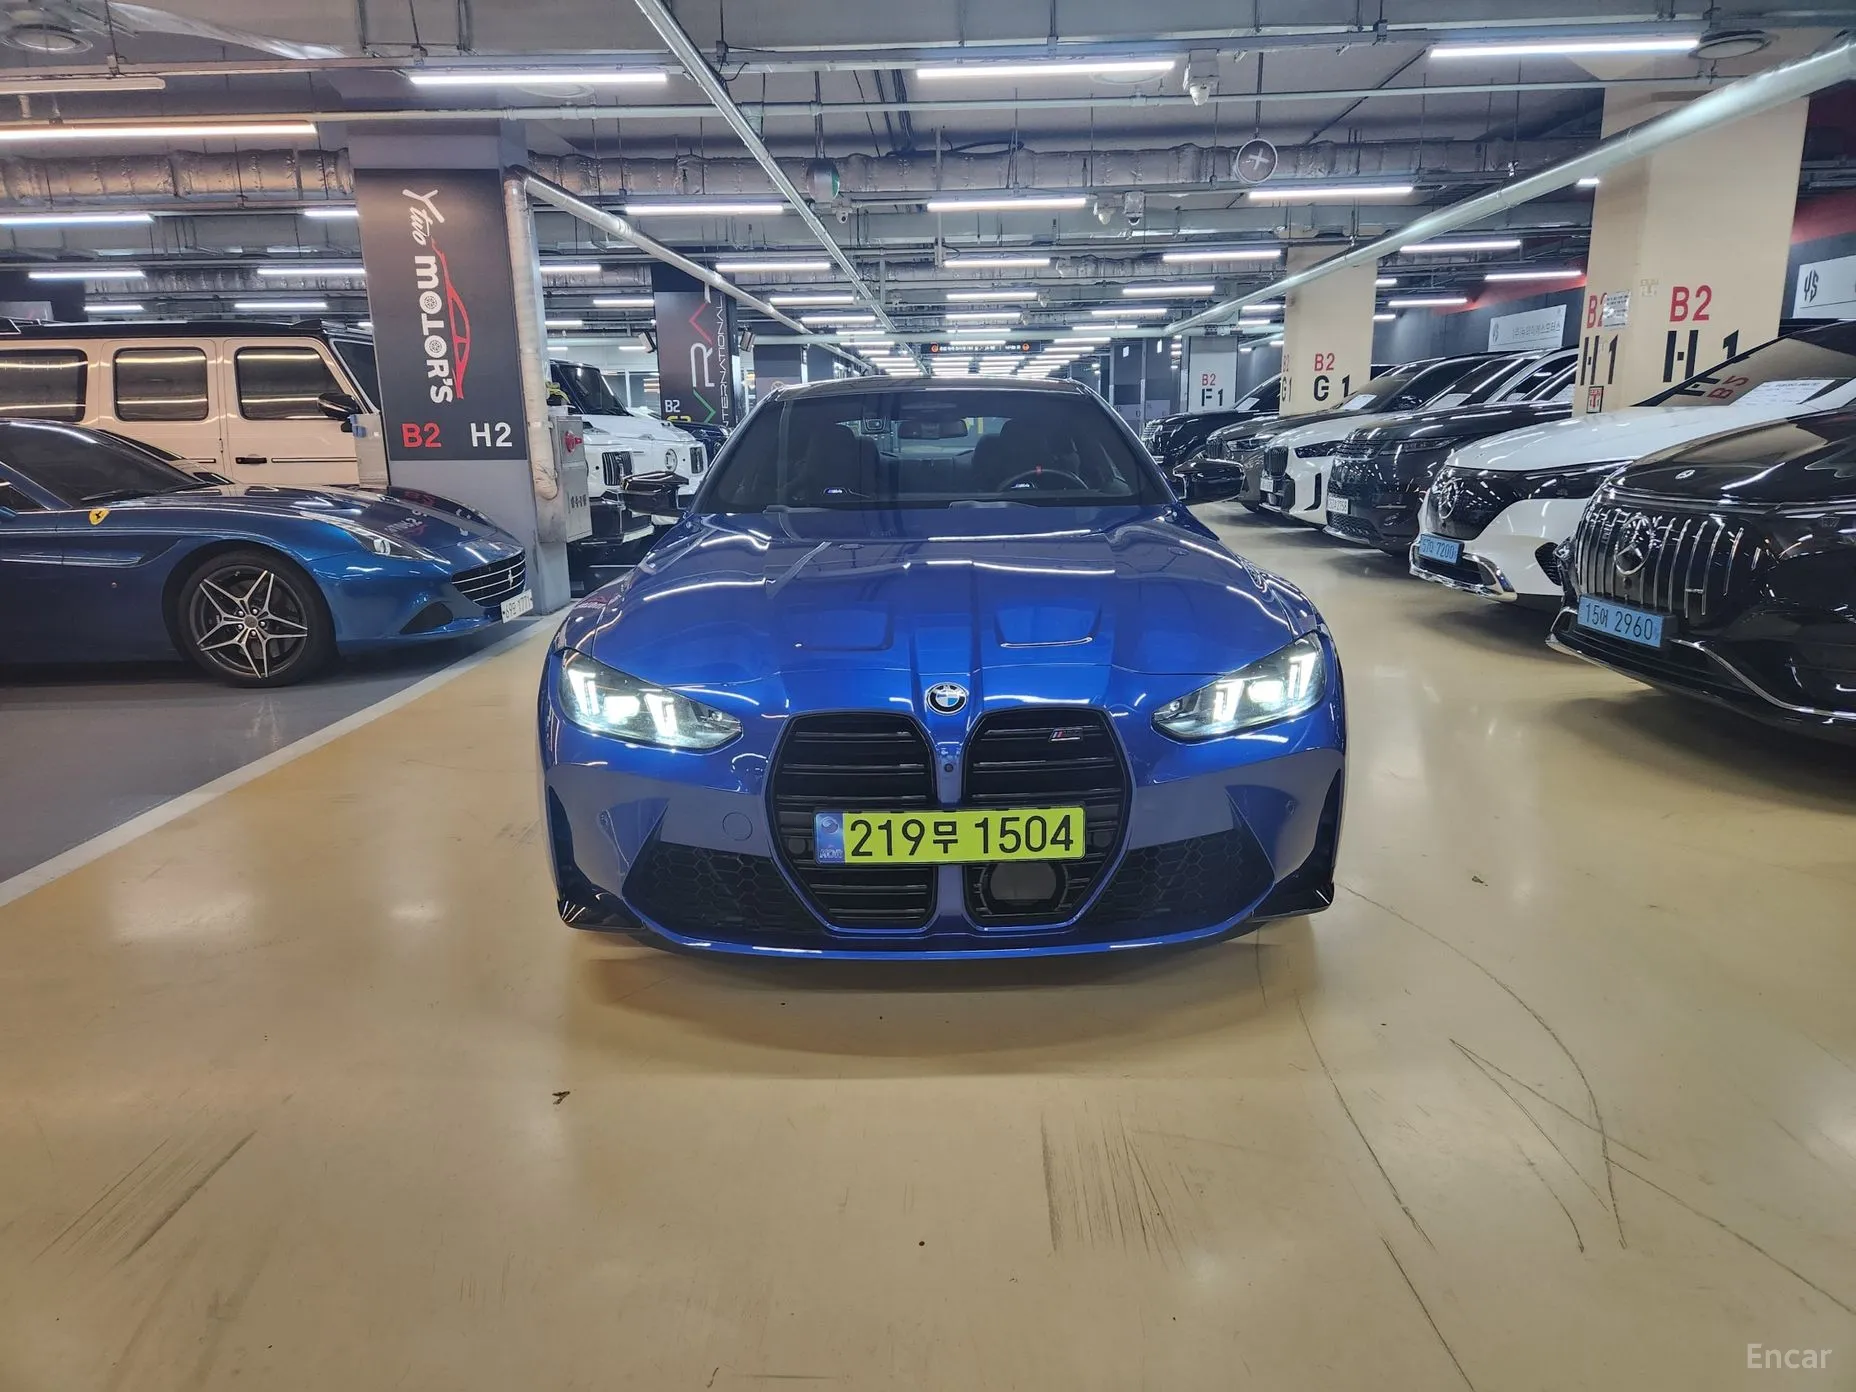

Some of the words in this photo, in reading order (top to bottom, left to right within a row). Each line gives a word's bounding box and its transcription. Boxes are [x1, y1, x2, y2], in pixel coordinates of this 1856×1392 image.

[1669, 285, 1713, 322] B2
[1313, 352, 1336, 371] B2
[1201, 373, 1217, 386] B2
[664, 399, 681, 413] B2
[401, 422, 442, 448] B2
[470, 422, 513, 447] H2
[1585, 602, 1609, 628] 15어
[1614, 610, 1653, 640] 2960
[850, 818, 958, 857] 219무
[974, 814, 1074, 854] 1504
